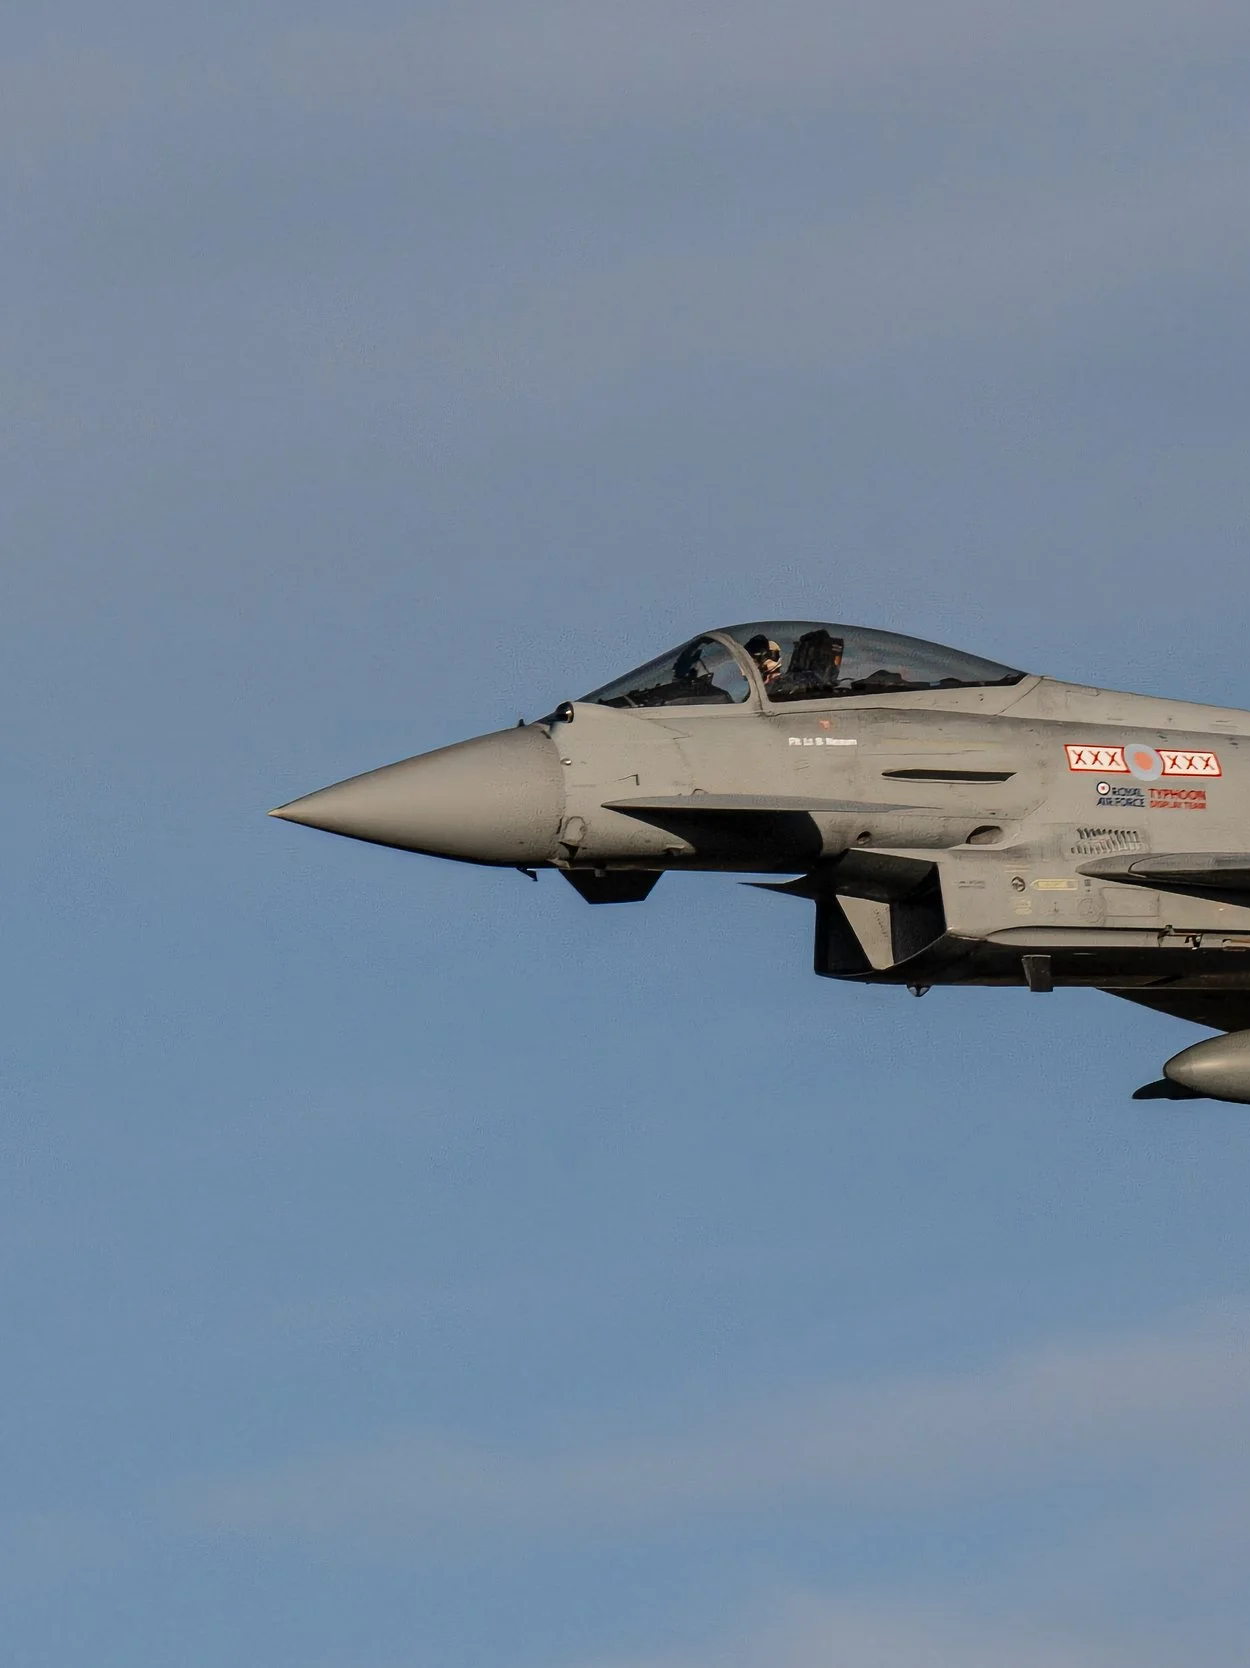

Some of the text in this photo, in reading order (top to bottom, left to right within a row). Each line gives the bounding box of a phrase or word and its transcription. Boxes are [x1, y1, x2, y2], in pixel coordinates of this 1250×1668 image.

[1071, 749, 1121, 767] XXX
[1166, 755, 1215, 770] XXX
[1111, 787, 1145, 797] ROYAL
[1148, 788, 1207, 801] TYPHOON
[1114, 797, 1146, 808] FORCE
